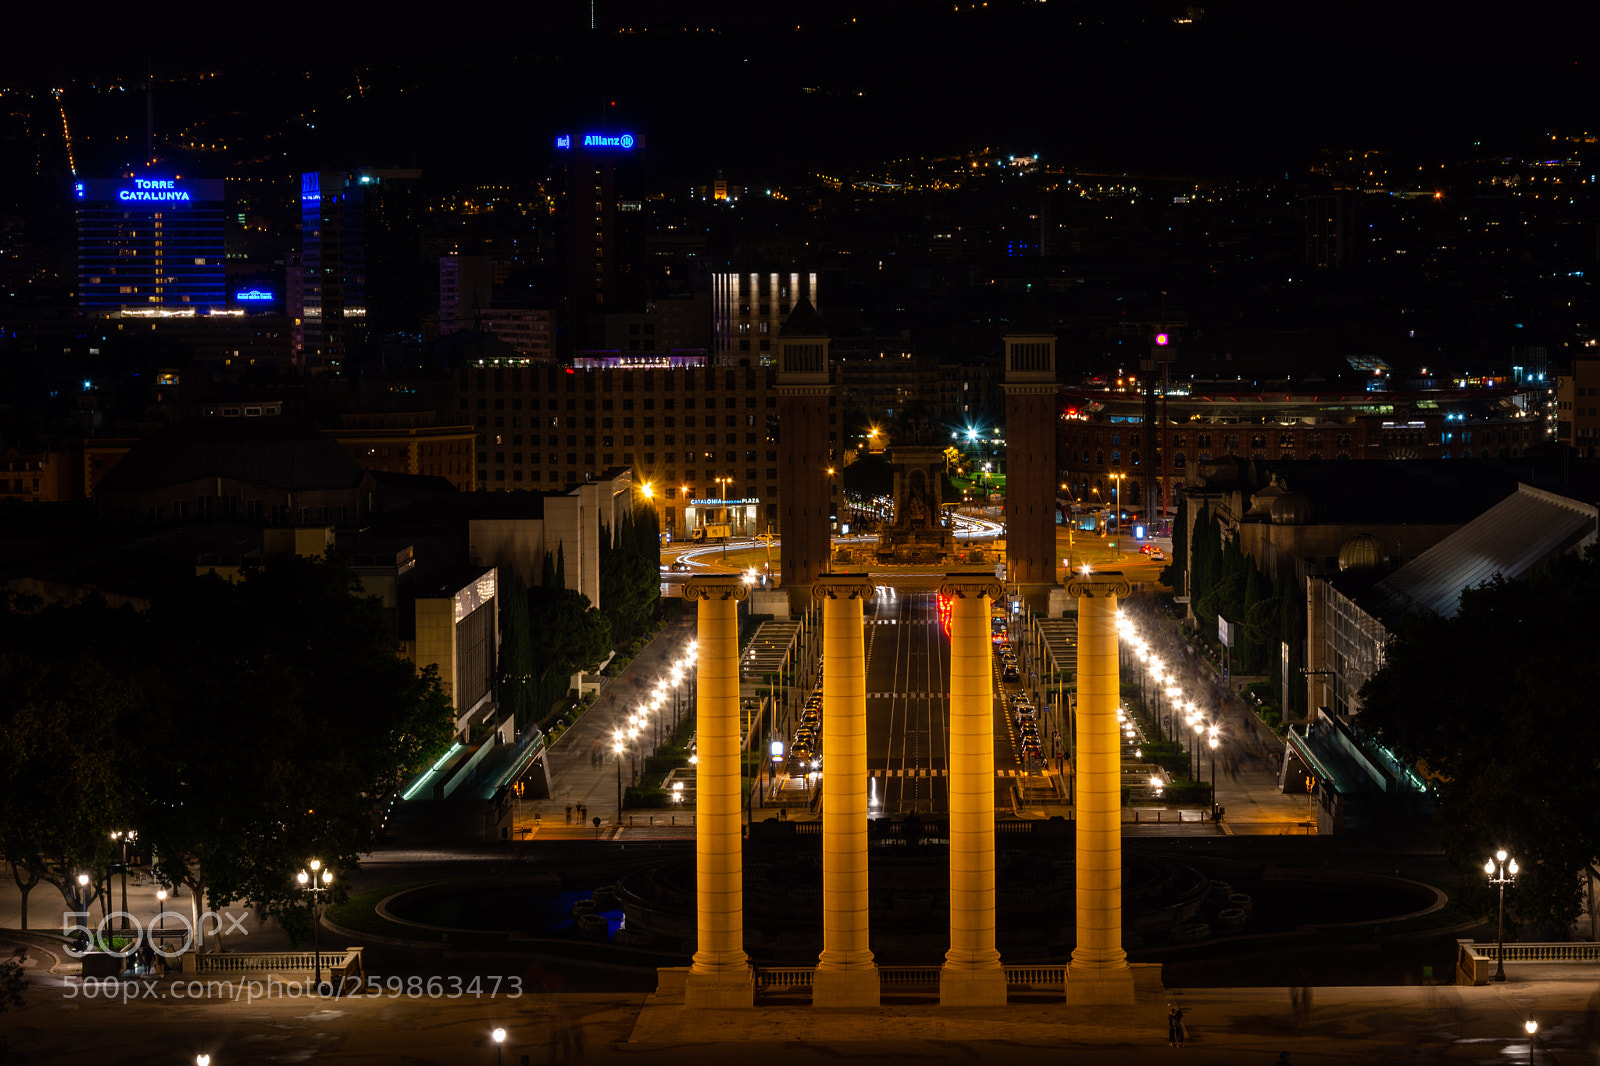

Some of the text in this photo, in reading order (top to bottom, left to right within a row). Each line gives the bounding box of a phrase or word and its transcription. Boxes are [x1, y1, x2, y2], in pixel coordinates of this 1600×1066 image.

[584, 135, 620, 146] Allianz
[135, 179, 175, 189] TORRE
[120, 190, 190, 201] CATALUNYA
